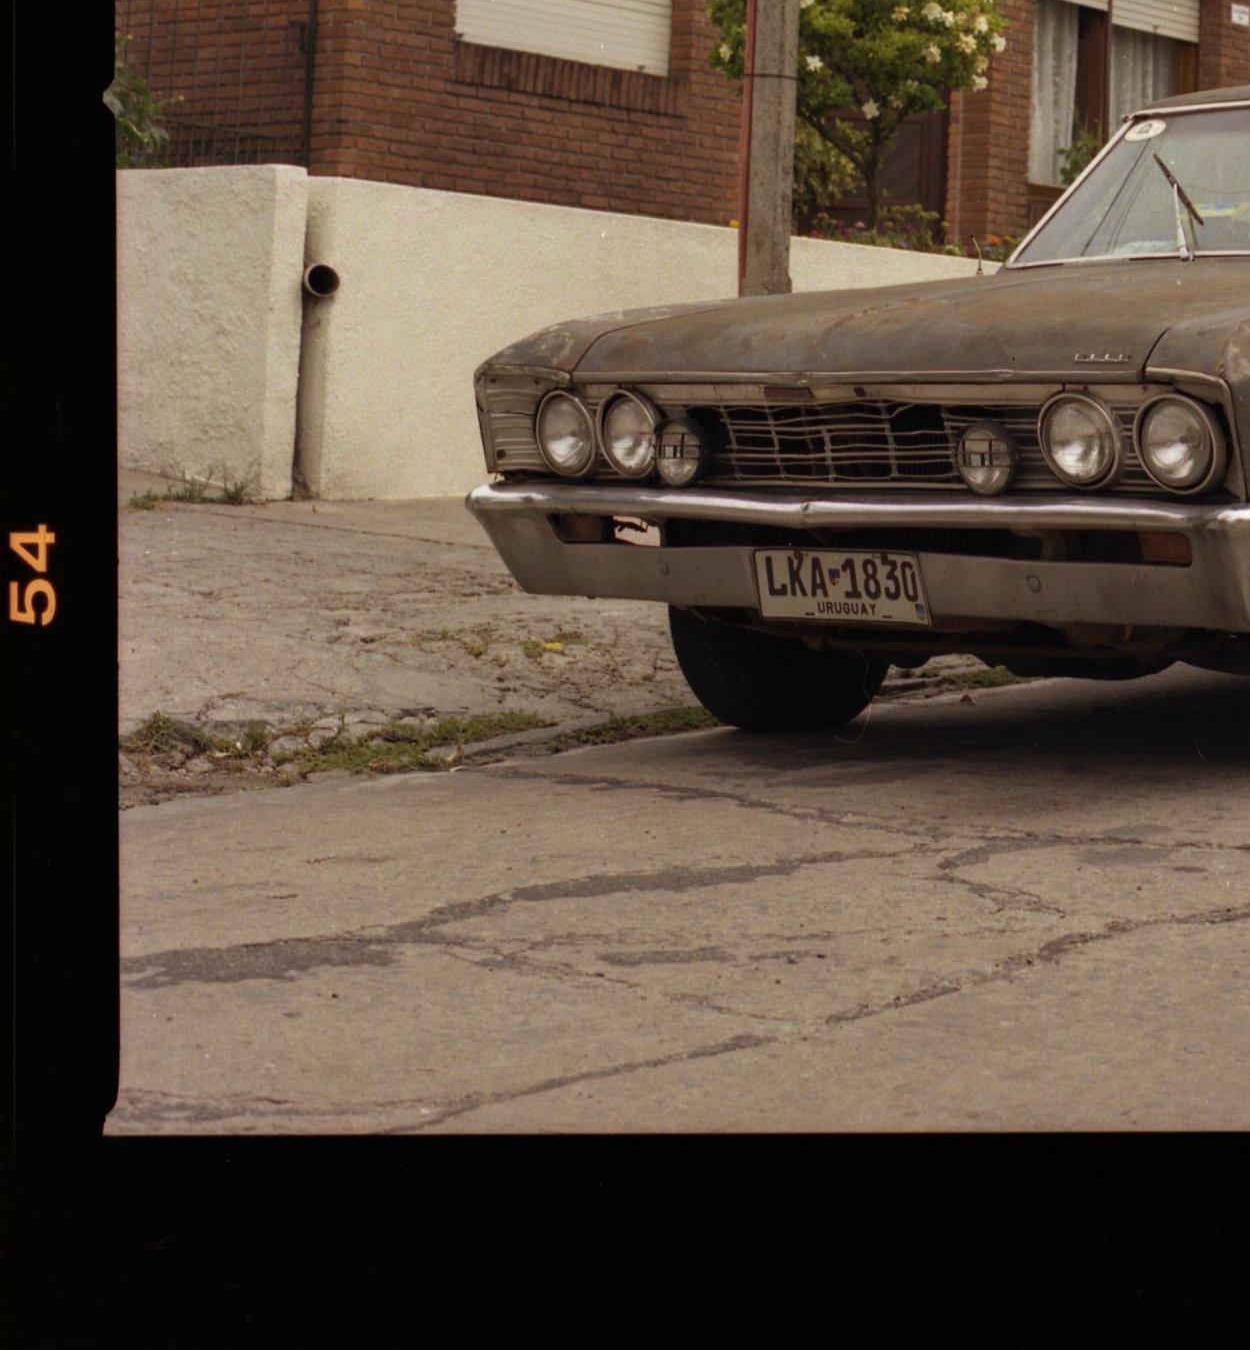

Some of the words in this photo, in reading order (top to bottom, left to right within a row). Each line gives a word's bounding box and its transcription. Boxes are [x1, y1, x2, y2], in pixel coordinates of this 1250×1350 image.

[9, 523, 57, 627] 54
[764, 555, 829, 598] LKA
[840, 557, 919, 603] 1830
[816, 601, 877, 616] URUGUAY
